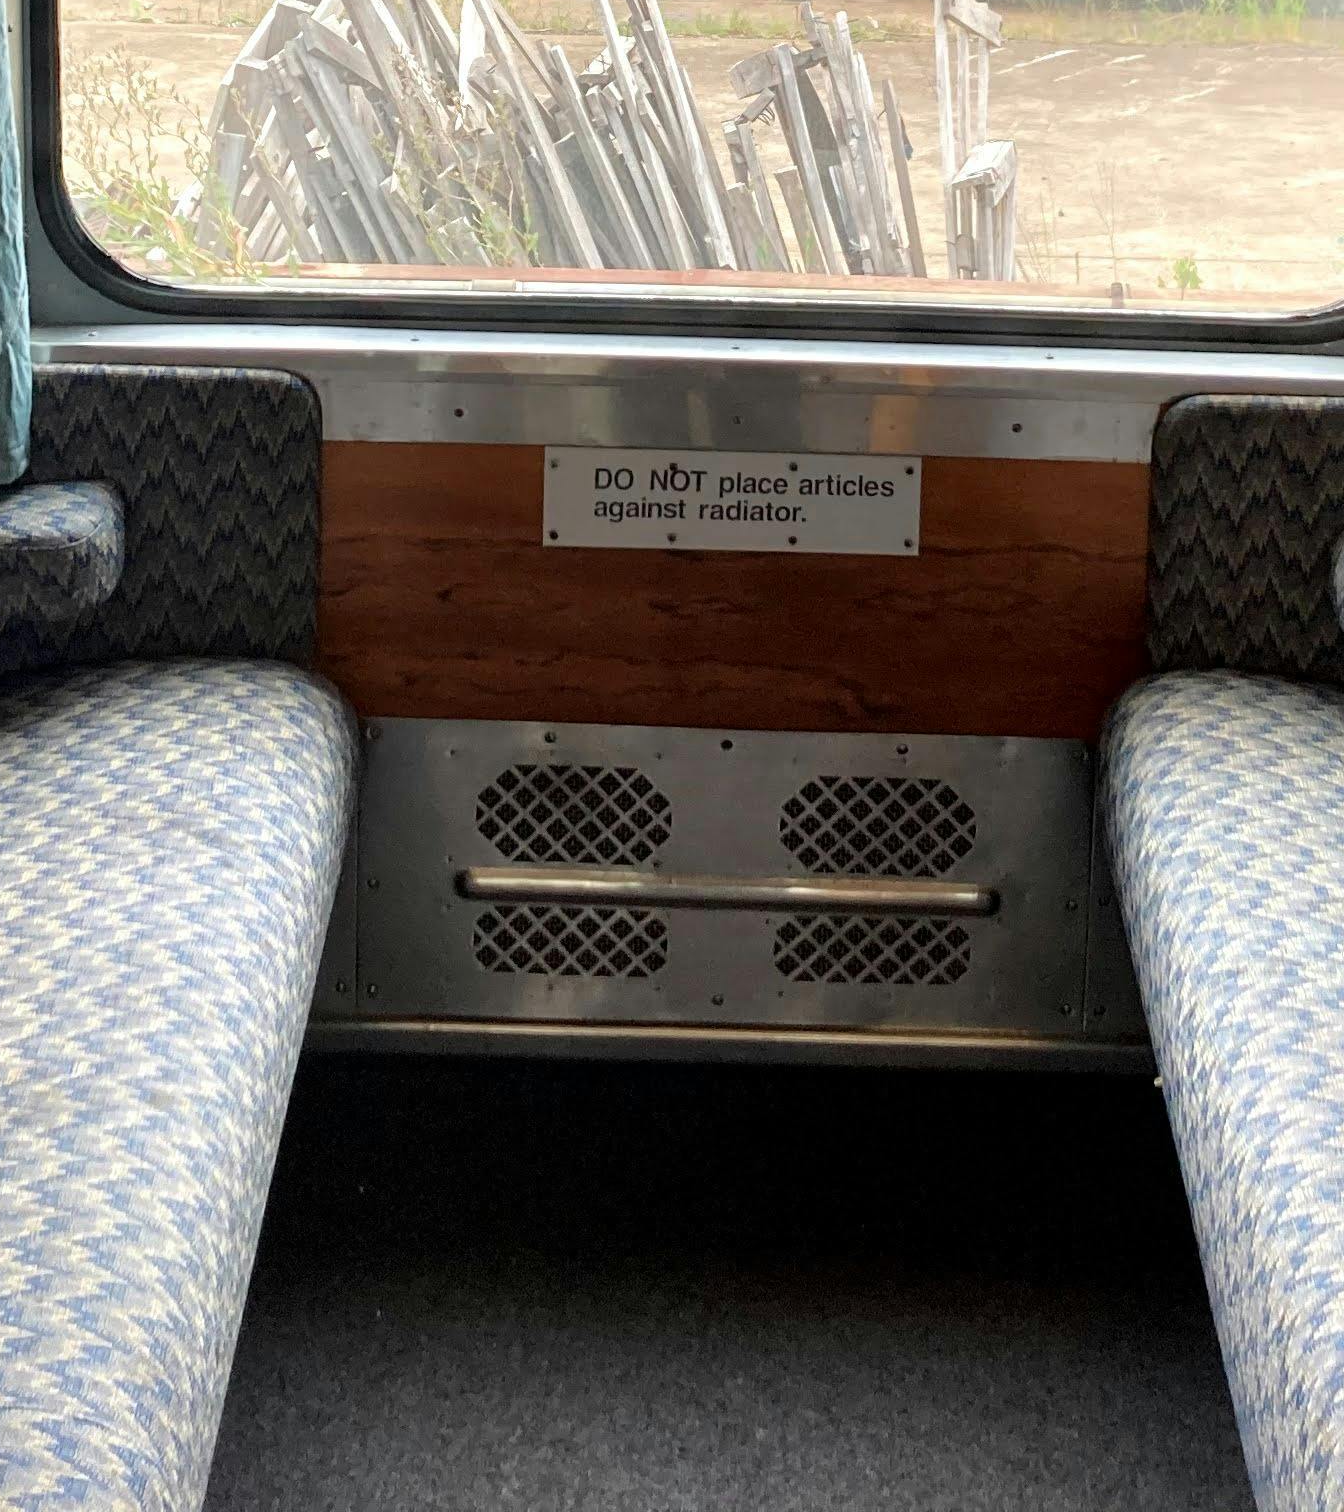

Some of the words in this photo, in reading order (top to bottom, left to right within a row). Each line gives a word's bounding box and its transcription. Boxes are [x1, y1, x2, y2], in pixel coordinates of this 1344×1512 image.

[594, 467, 634, 490] DO
[650, 469, 707, 492] NOT
[718, 472, 788, 498] place
[798, 474, 895, 498] articles
[594, 496, 686, 523] against
[699, 500, 807, 523] radiator.
